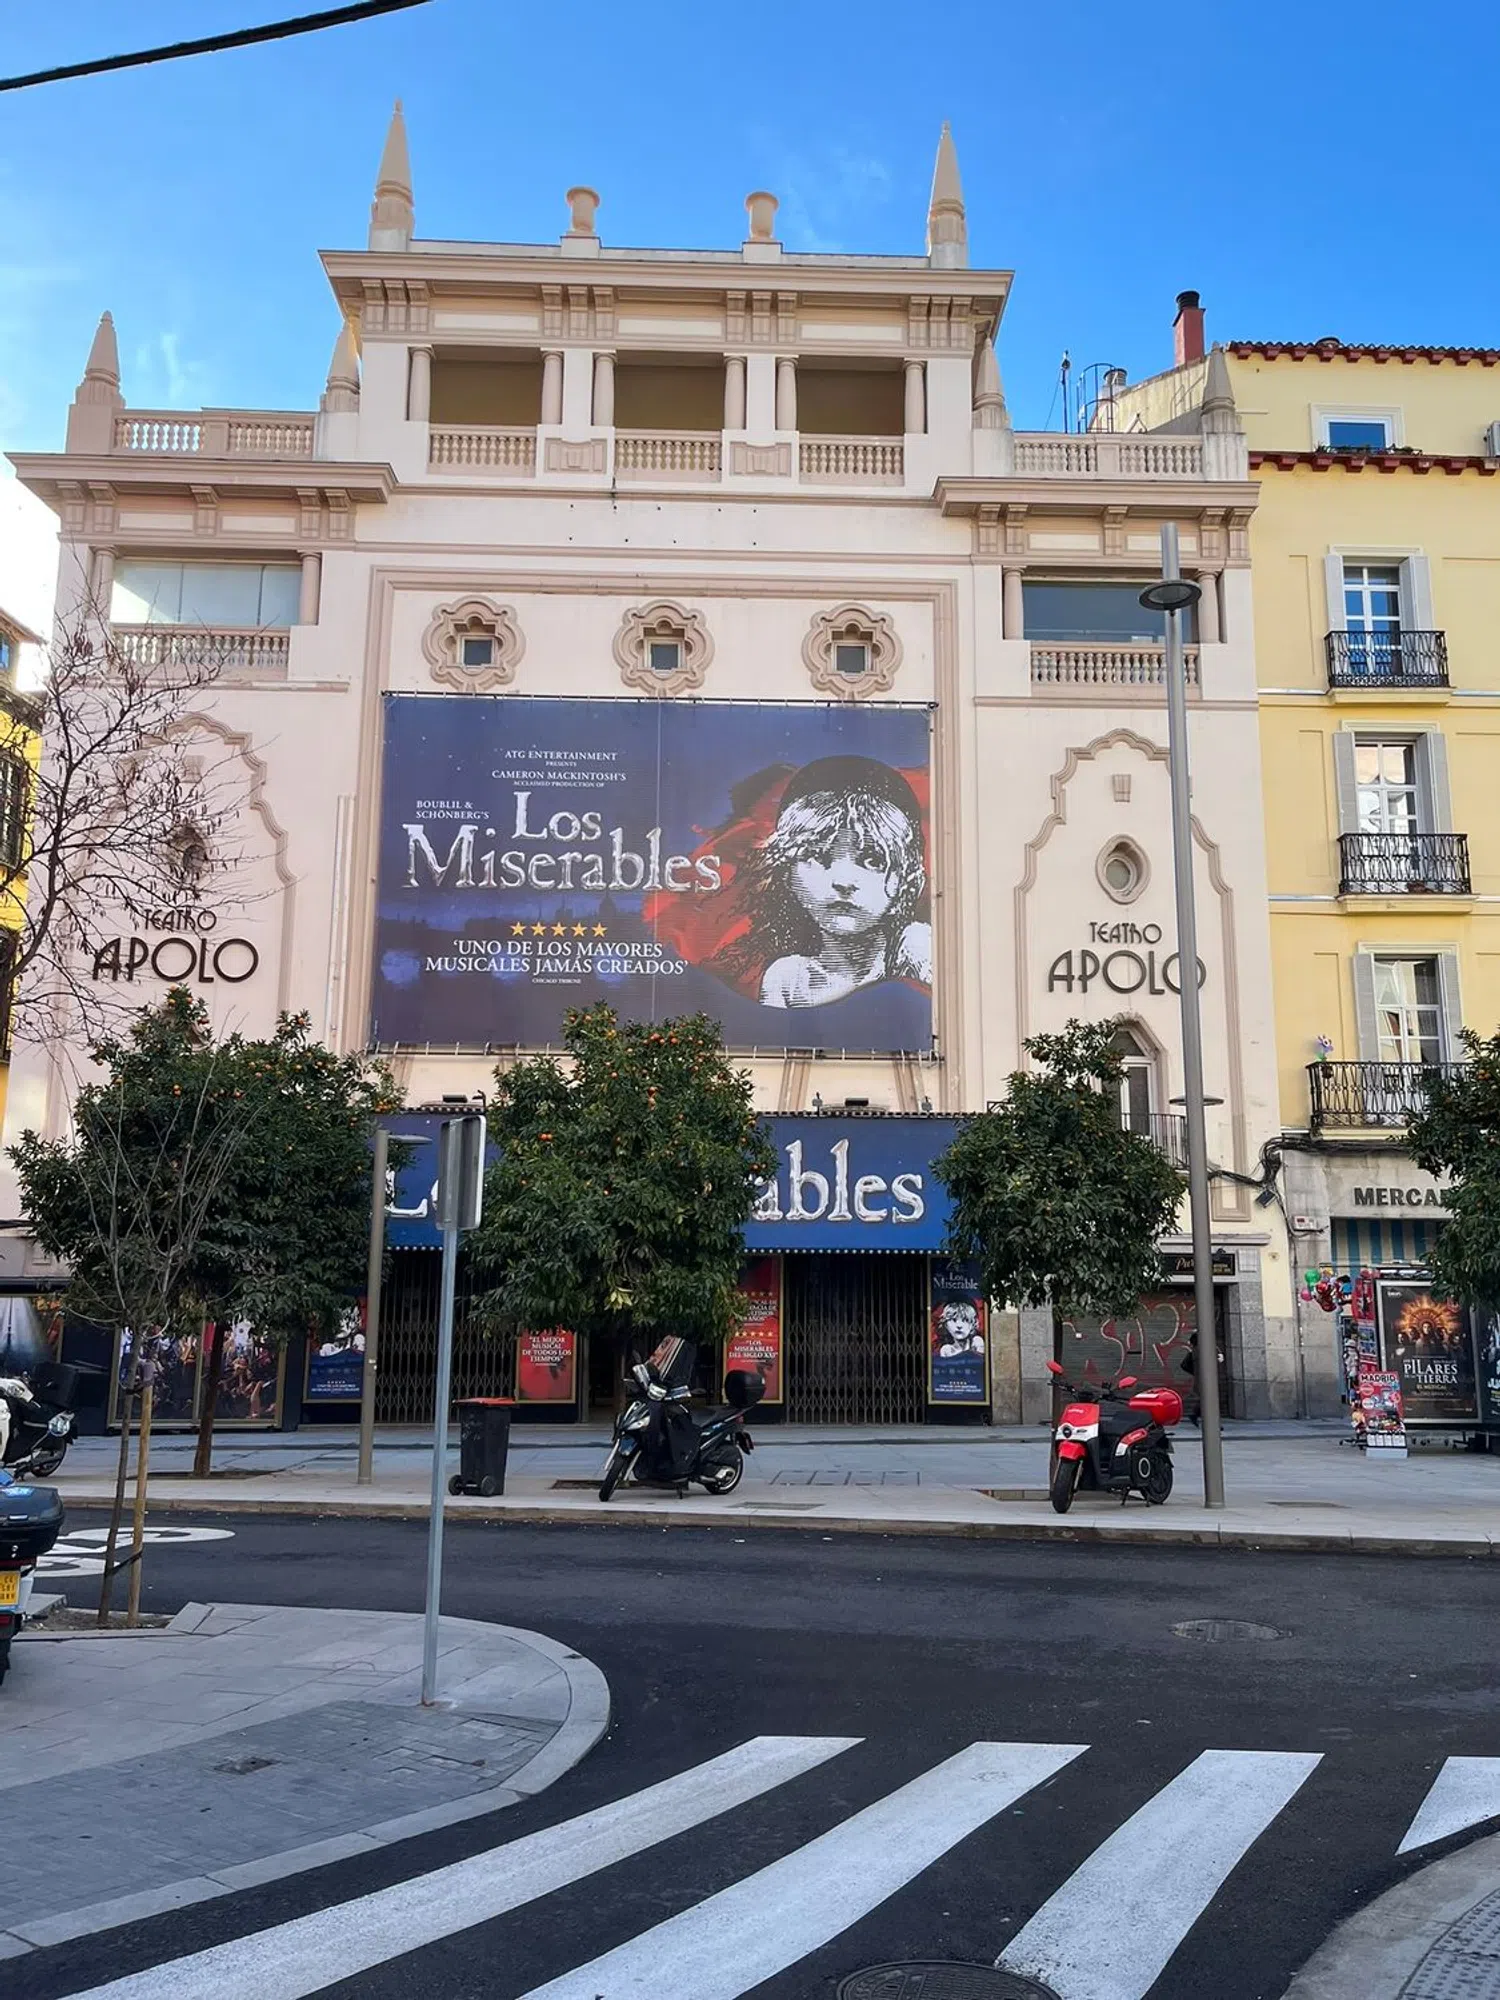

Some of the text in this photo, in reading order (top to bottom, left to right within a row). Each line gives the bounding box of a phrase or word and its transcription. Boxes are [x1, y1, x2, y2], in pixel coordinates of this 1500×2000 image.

[504, 750, 618, 761] ATG ENTERTAINMENT
[491, 769, 627, 781] CAMERON MACKINTOSH'S
[416, 800, 473, 809] BOUBLIL &
[415, 808, 490, 819] SCHÖNBERG'S
[511, 790, 602, 842] Los
[402, 823, 721, 893] Miserables
[143, 905, 217, 931] TEATRO
[1089, 921, 1163, 944] TEATRO
[506, 940, 533, 955] DE
[537, 941, 572, 956] LOS
[576, 941, 663, 957] MAYORES
[92, 937, 259, 983] APOLO
[425, 956, 530, 972] MUSICALES
[532, 955, 592, 975] JAMÁS
[1048, 949, 1207, 995] APOLO
[933, 1277, 979, 1290] Miserable
[1403, 1359, 1458, 1375] PILARES
[1361, 1374, 1396, 1382] MADRID
[1416, 1374, 1458, 1384] TIERRA
